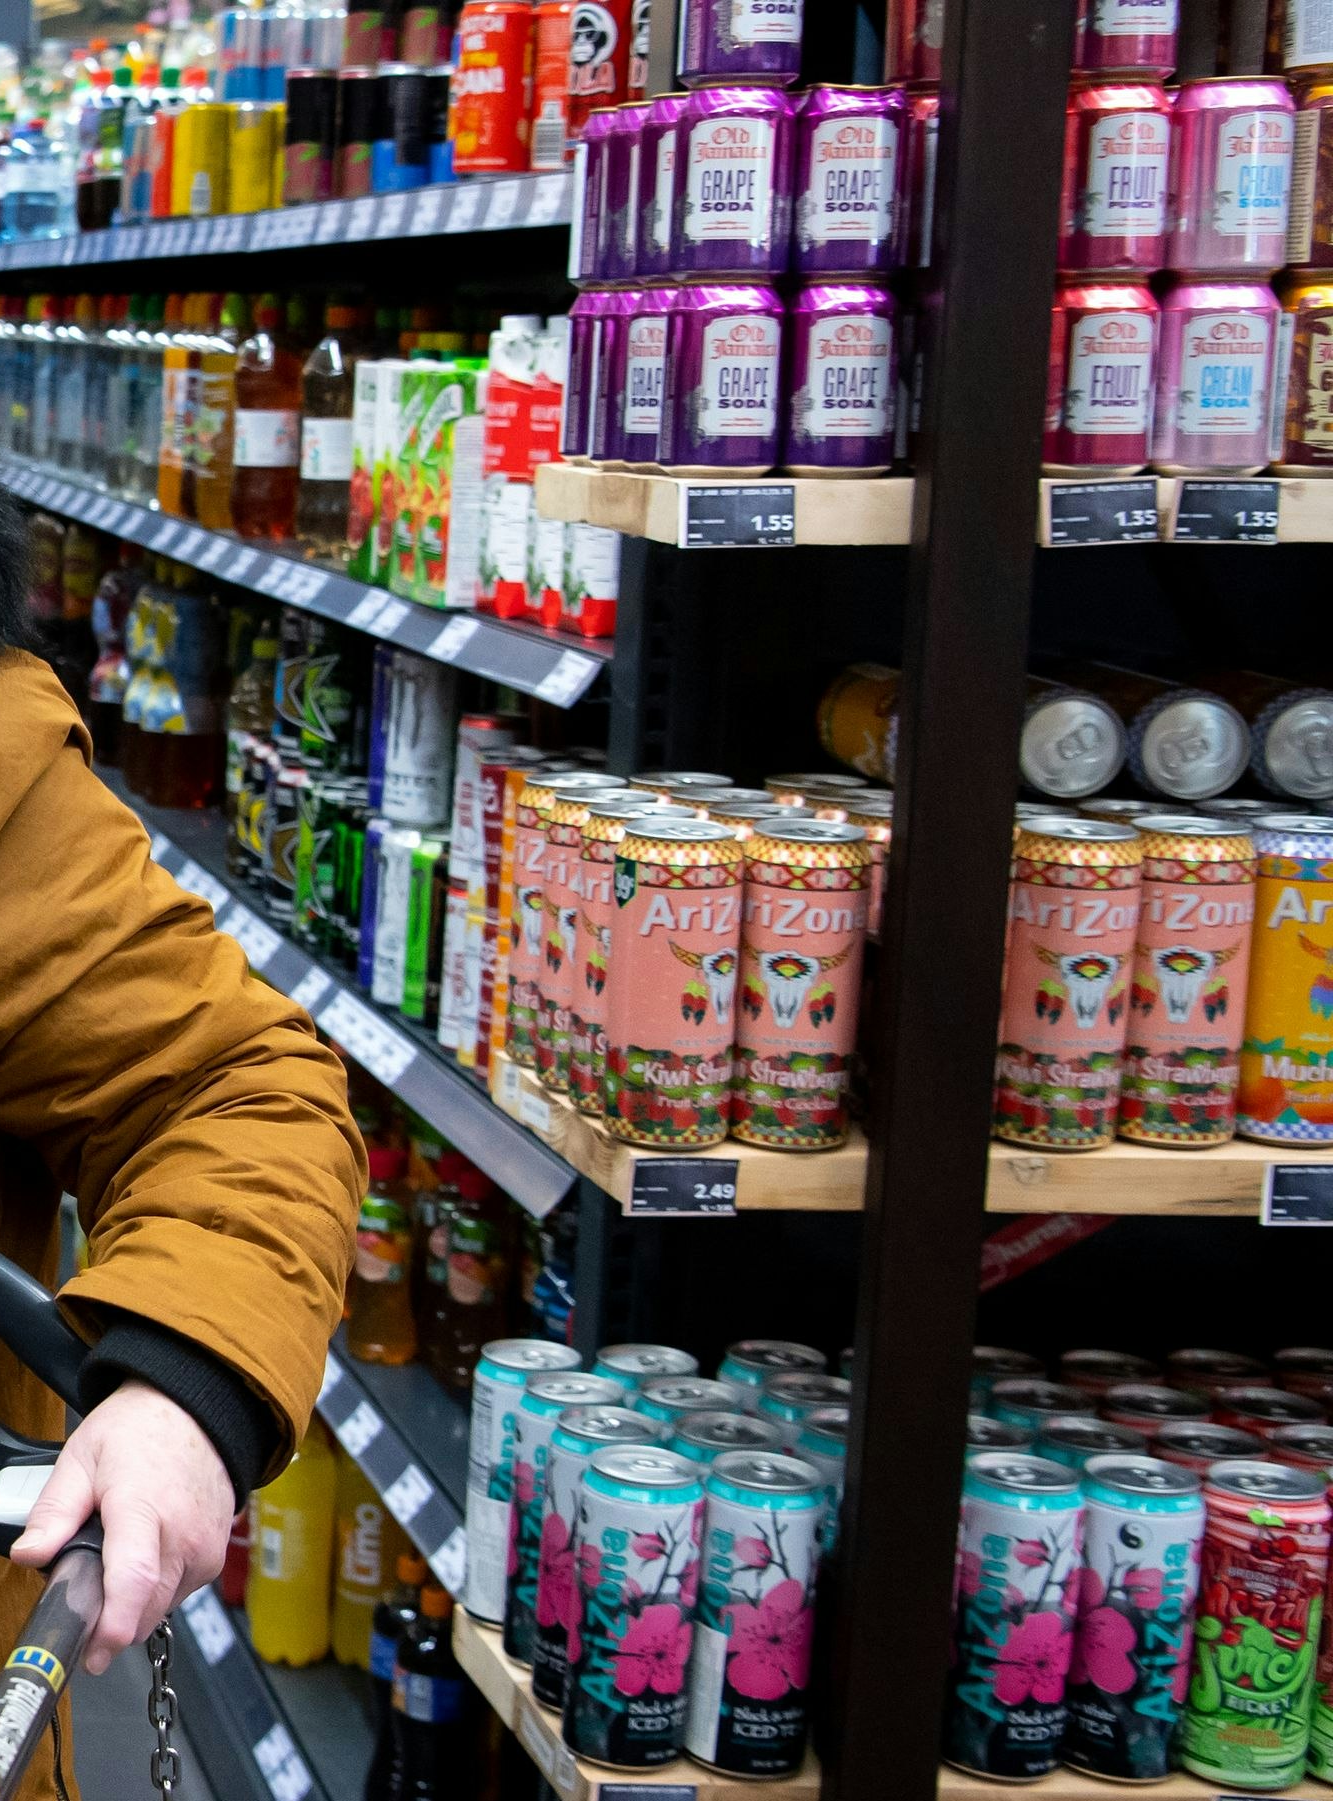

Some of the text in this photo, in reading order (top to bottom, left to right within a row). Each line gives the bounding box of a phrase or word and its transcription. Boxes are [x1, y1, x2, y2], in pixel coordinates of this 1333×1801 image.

[750, 2, 796, 15] SODA
[710, 126, 750, 146] Old
[836, 126, 876, 146] Old
[693, 141, 767, 164] Jamaica
[817, 141, 892, 164] Jamaica
[702, 169, 756, 201] GRAPE
[825, 169, 882, 200] GRAPE
[1108, 166, 1158, 201] FRUIT
[700, 201, 754, 213] SODA
[824, 201, 879, 213] SODA
[728, 323, 766, 343] Old
[835, 323, 875, 343] Old
[710, 340, 777, 360] Jamaica
[817, 340, 888, 360] Jamaica
[718, 366, 769, 398] GRAPE
[824, 366, 879, 398] GRAPE
[1091, 365, 1142, 400] FRUIT
[1200, 365, 1254, 398] CREAM
[718, 398, 767, 409] SODA
[822, 398, 877, 410] SODA
[1090, 399, 1139, 408] PUNCH
[1200, 397, 1250, 409] SODA
[751, 514, 794, 532] 1.55
[1114, 509, 1158, 526] 1.35
[1235, 511, 1278, 527] 1.35
[644, 1061, 691, 1088] Kiwi
[694, 1184, 735, 1201] 2.49
[581, 1526, 630, 1714] AriZona
[955, 1533, 1011, 1723] AriZona
[1134, 1543, 1190, 1723] AriZona
